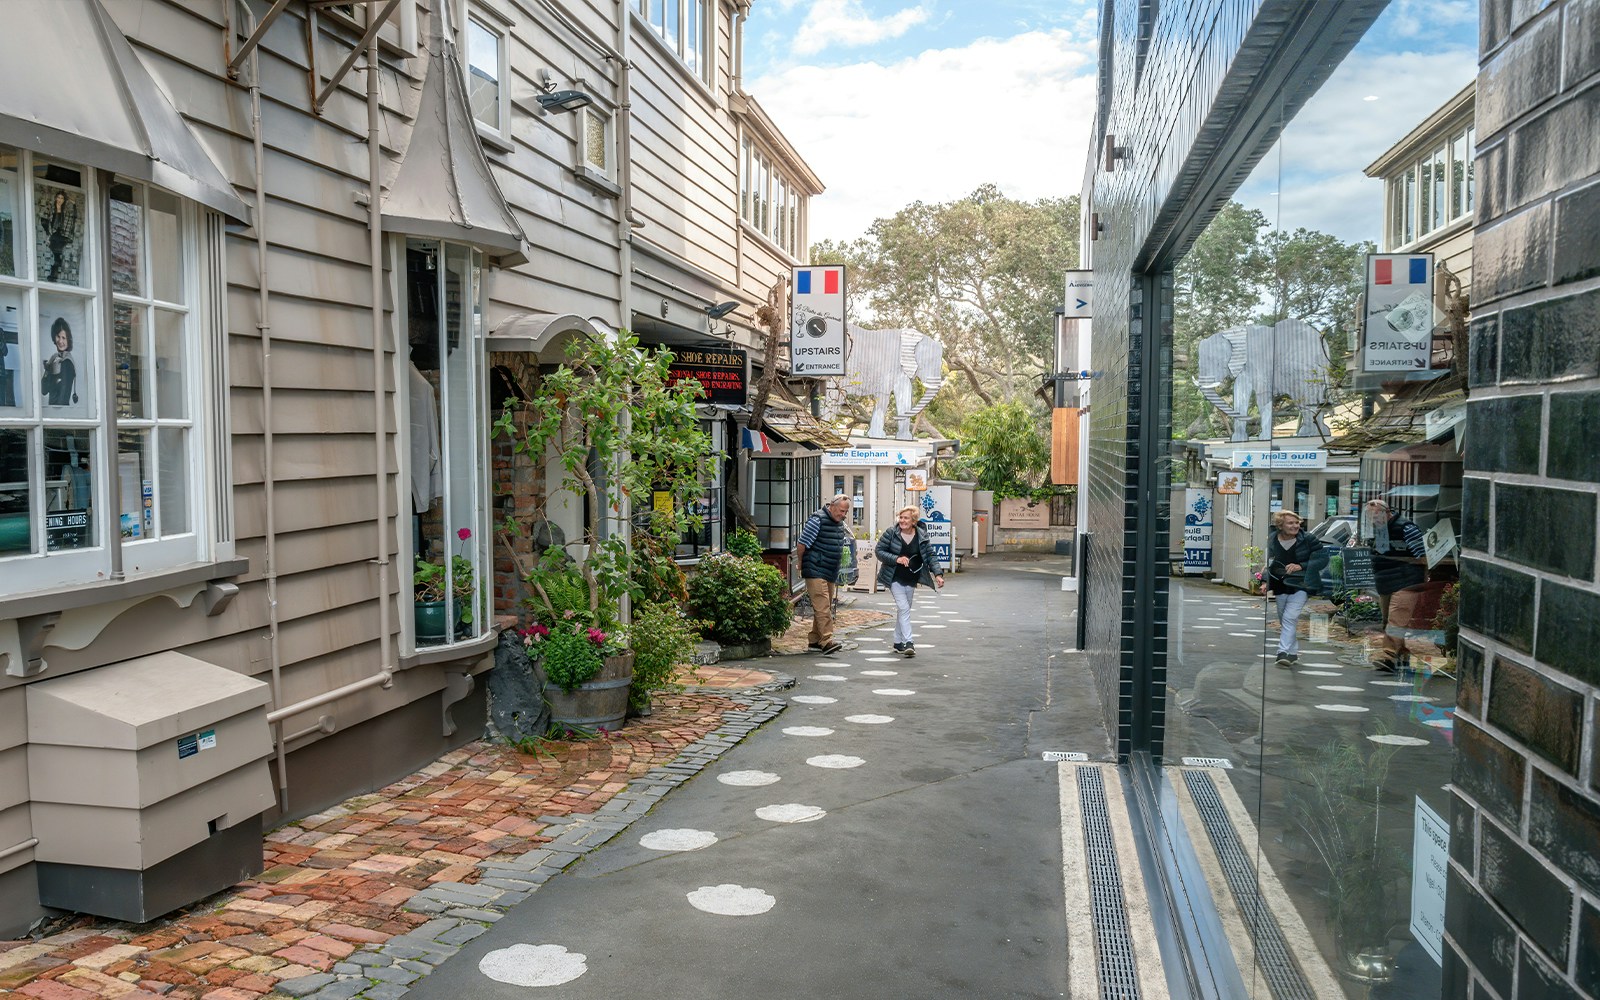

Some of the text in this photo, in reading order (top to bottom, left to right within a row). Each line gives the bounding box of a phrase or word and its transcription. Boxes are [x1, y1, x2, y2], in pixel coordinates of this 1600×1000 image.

[795, 347, 841, 356] UPSTAIRS
[681, 352, 703, 363] SHOE
[705, 353, 743, 366] REPAIRS
[696, 371, 711, 380] SHOE
[711, 381, 743, 390] ENGRAVING
[851, 450, 889, 458] Elephant
[46, 515, 87, 527] ENING HOURS
[927, 523, 943, 531] Blue
[926, 530, 950, 538] ephant
[1421, 816, 1447, 853] This space
